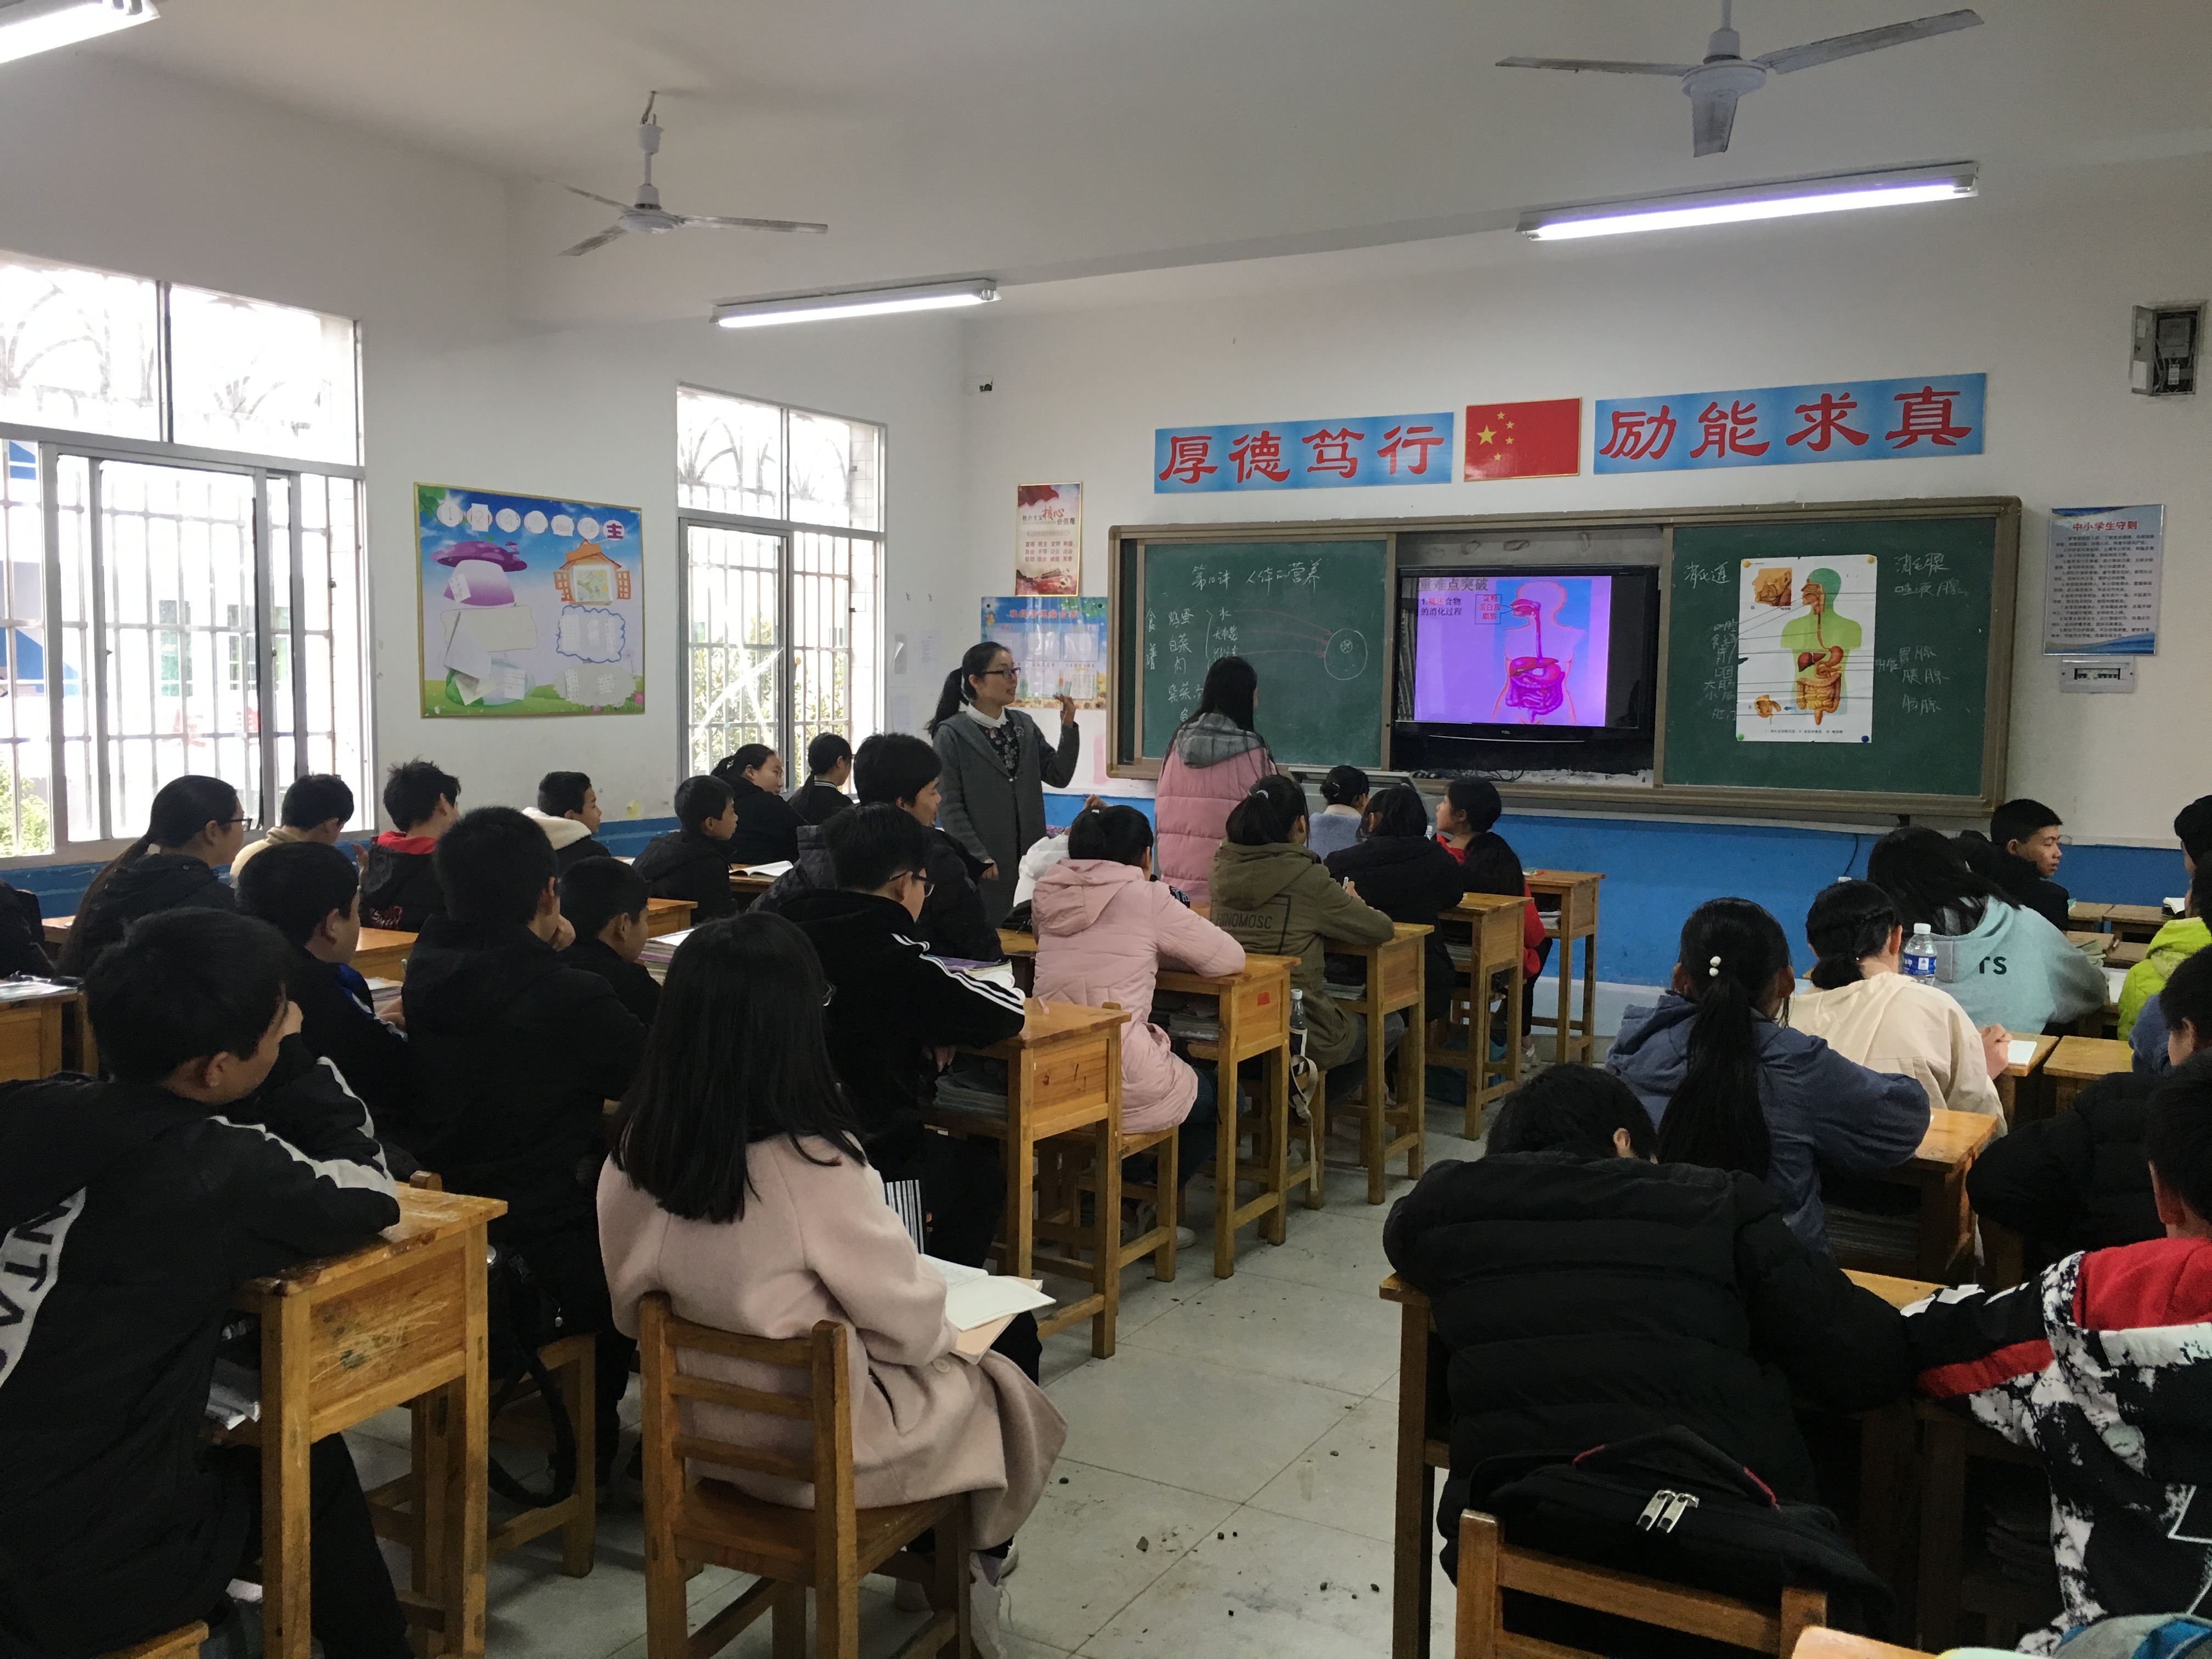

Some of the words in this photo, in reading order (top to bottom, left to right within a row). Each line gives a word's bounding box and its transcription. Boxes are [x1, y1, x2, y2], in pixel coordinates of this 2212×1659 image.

[1598, 385, 1972, 461] 励能求真
[1158, 425, 1445, 484] 厚德笃行
[606, 523, 624, 539] 主
[2073, 520, 2138, 532] 中小学生守则
[1191, 563, 1231, 591] 第10讲
[1245, 558, 1322, 596] 人体的营养
[1419, 578, 1488, 591] 重难点突破
[1683, 560, 1731, 589] 消化道
[1167, 608, 1194, 629] 鸡蛋
[1421, 607, 1462, 616] 的消化过程
[1169, 633, 1194, 653] 白菜
